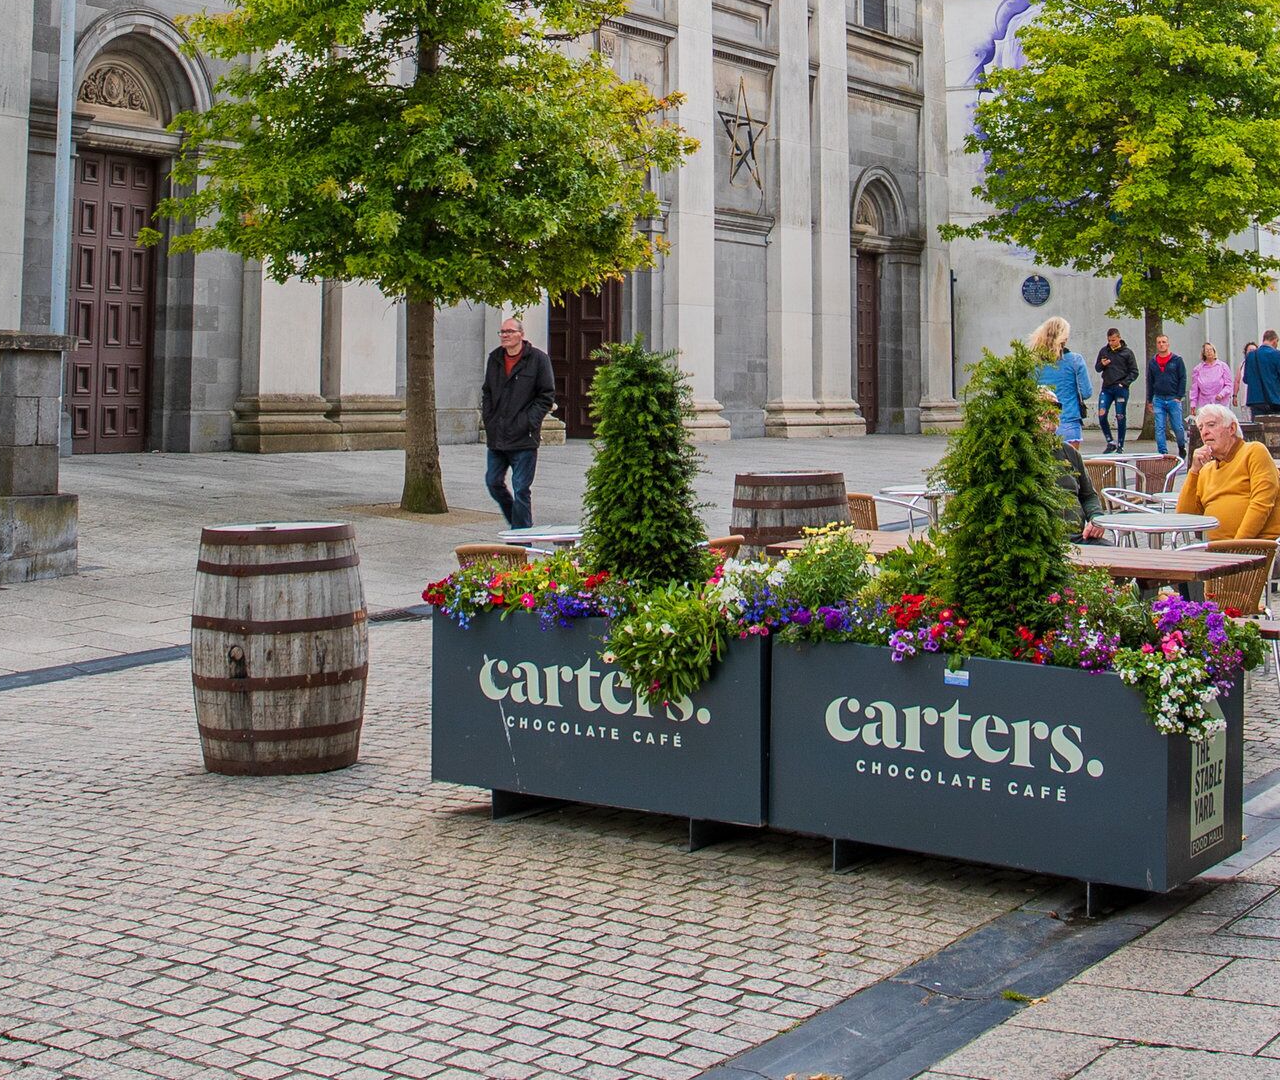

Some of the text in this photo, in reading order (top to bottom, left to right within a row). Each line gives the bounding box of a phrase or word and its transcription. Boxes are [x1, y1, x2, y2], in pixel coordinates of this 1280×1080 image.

[479, 658, 712, 725] carters.
[507, 716, 682, 747] CHOCOLATE CAFÉ
[825, 696, 1104, 777] carters.
[1196, 740, 1210, 766] THE
[856, 760, 1067, 802] CHOCOLATE CAFÉ
[1194, 759, 1223, 796] STABLE
[1194, 792, 1216, 825] YARD.
[1192, 827, 1223, 852] FOOD HALL
